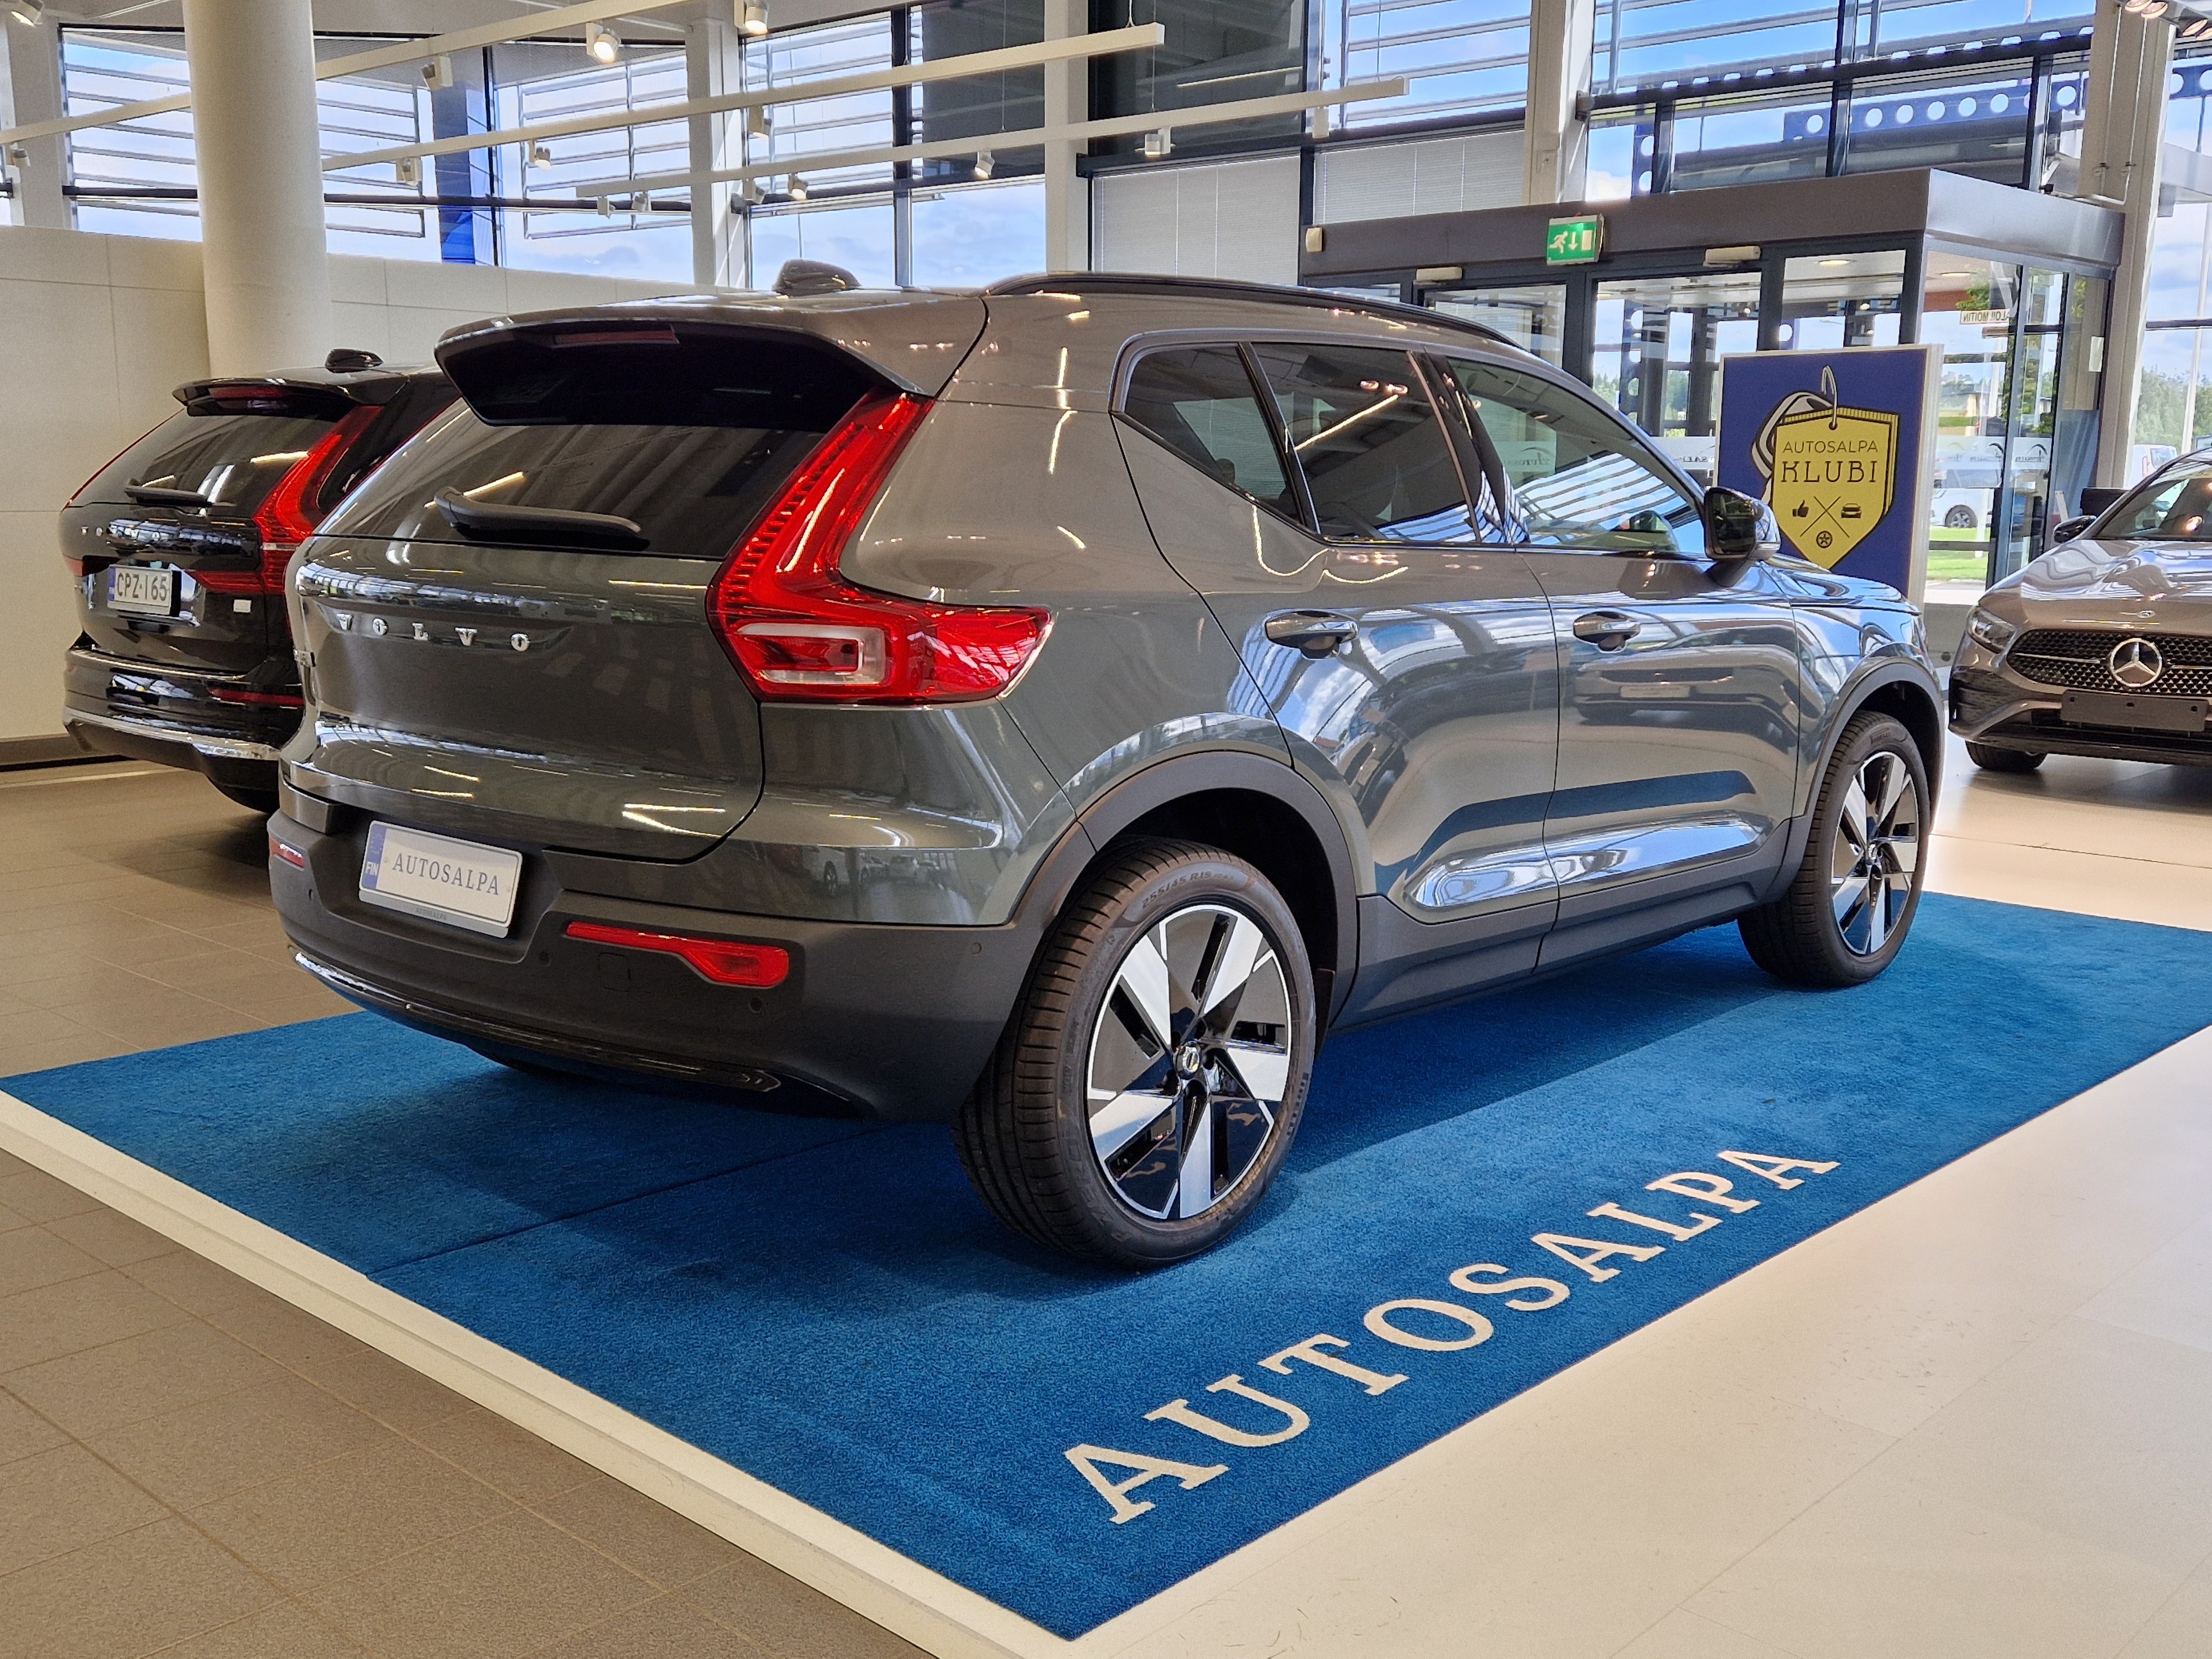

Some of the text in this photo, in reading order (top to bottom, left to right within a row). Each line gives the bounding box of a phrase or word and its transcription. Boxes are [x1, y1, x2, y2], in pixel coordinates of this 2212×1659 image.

[1783, 440, 1878, 453] AUTOSALPA
[1781, 461, 1877, 483] KLUBI
[336, 613, 531, 652] VOLVO
[365, 861, 379, 877] FIN
[392, 852, 499, 896] AUTOSALPA
[1142, 875, 1187, 910] 255/45
[1063, 1150, 1841, 1525] AUTOSALPA
